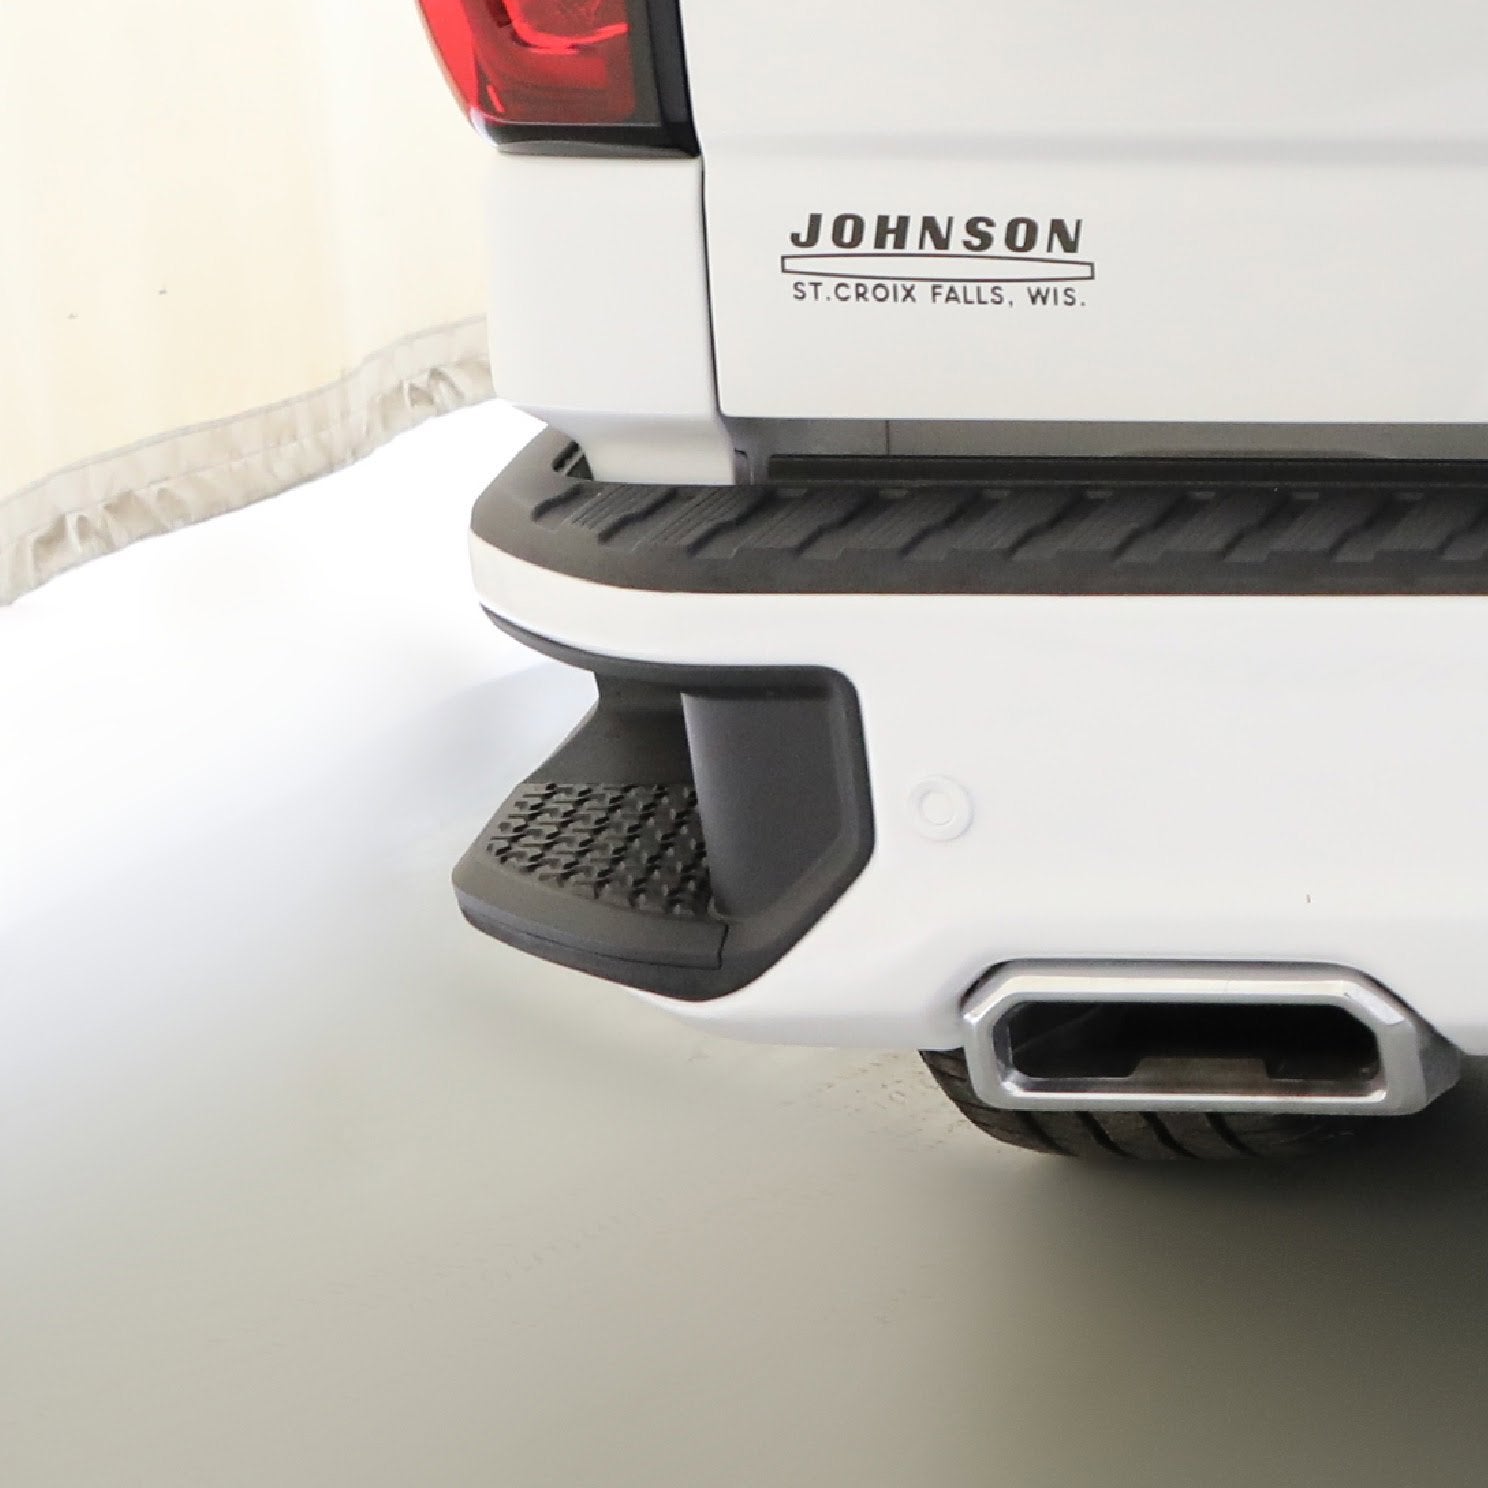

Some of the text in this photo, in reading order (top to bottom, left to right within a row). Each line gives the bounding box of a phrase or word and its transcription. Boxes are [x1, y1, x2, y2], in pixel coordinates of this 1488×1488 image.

[790, 212, 1083, 254] JOHNSON
[930, 283, 1014, 308] FALLS,
[1026, 285, 1087, 307] WIS.
